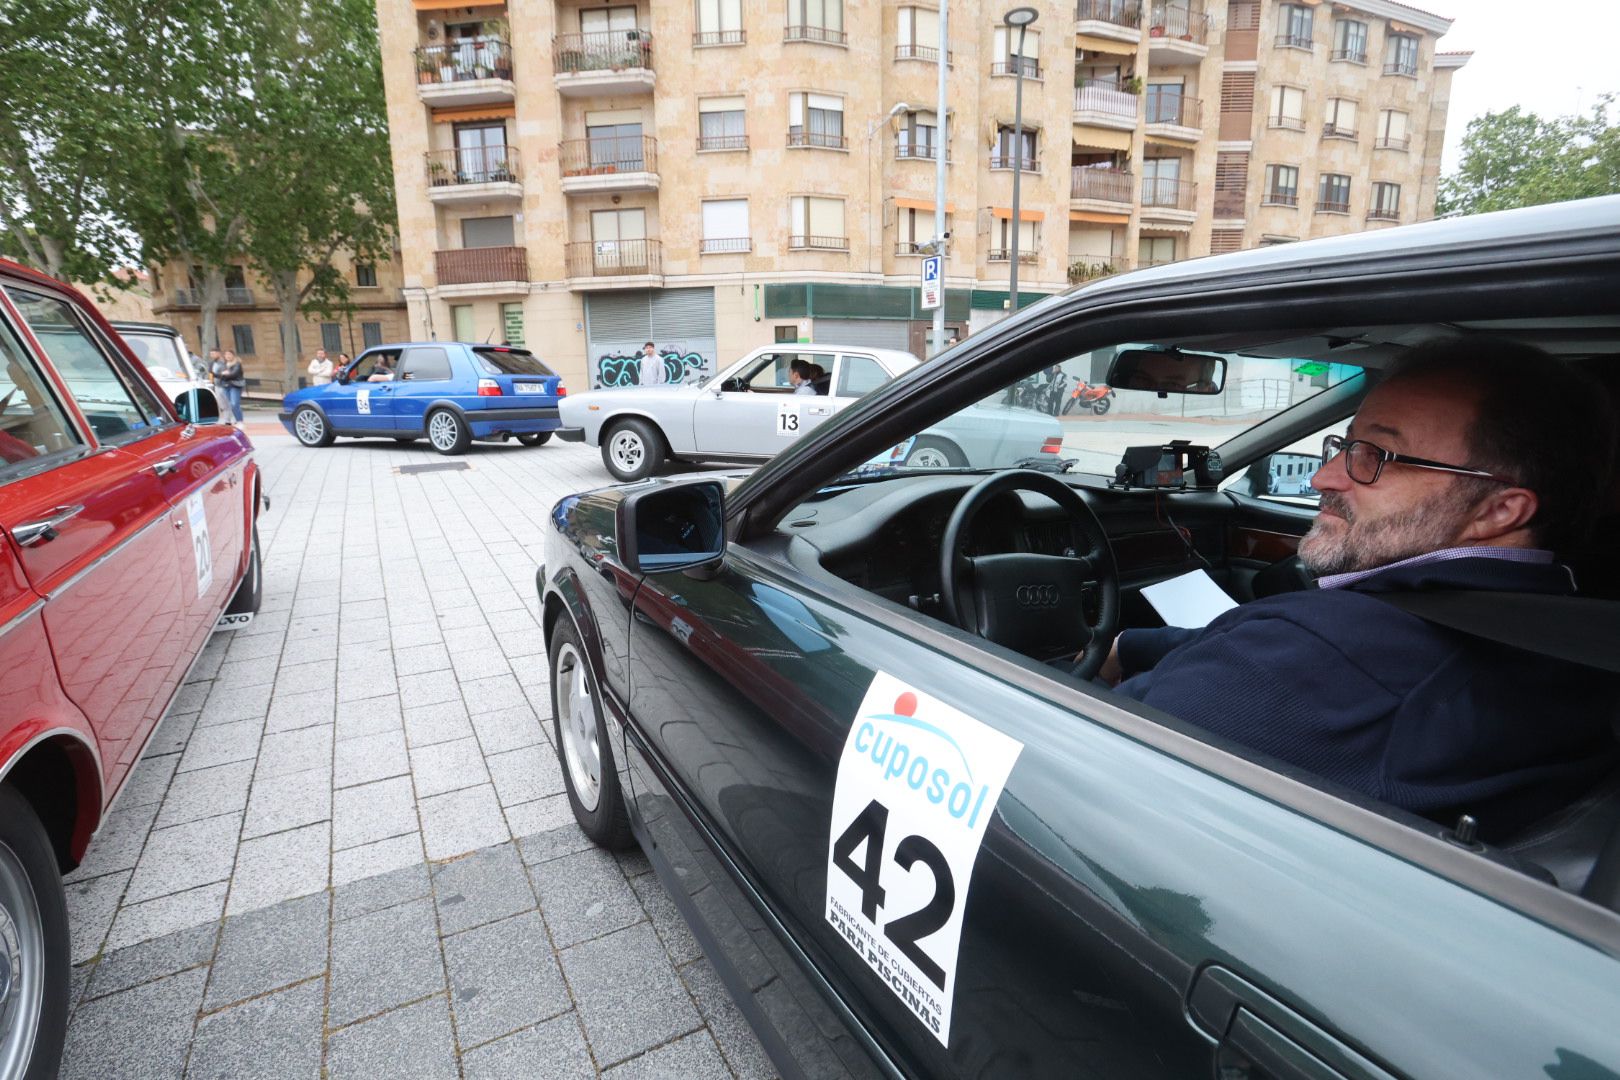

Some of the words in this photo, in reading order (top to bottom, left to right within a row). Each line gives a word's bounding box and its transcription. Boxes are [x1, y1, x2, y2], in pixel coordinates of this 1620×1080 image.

[780, 413, 799, 431] 13
[196, 529, 210, 581] 20
[855, 721, 989, 829] cuposol
[833, 798, 956, 993] 42
[830, 896, 877, 949] FABRICANTE
[878, 943, 890, 962] DE
[891, 958, 943, 1016] CUBIERTAS
[830, 909, 865, 955] PARA
[867, 948, 941, 1034] PISCINAS
